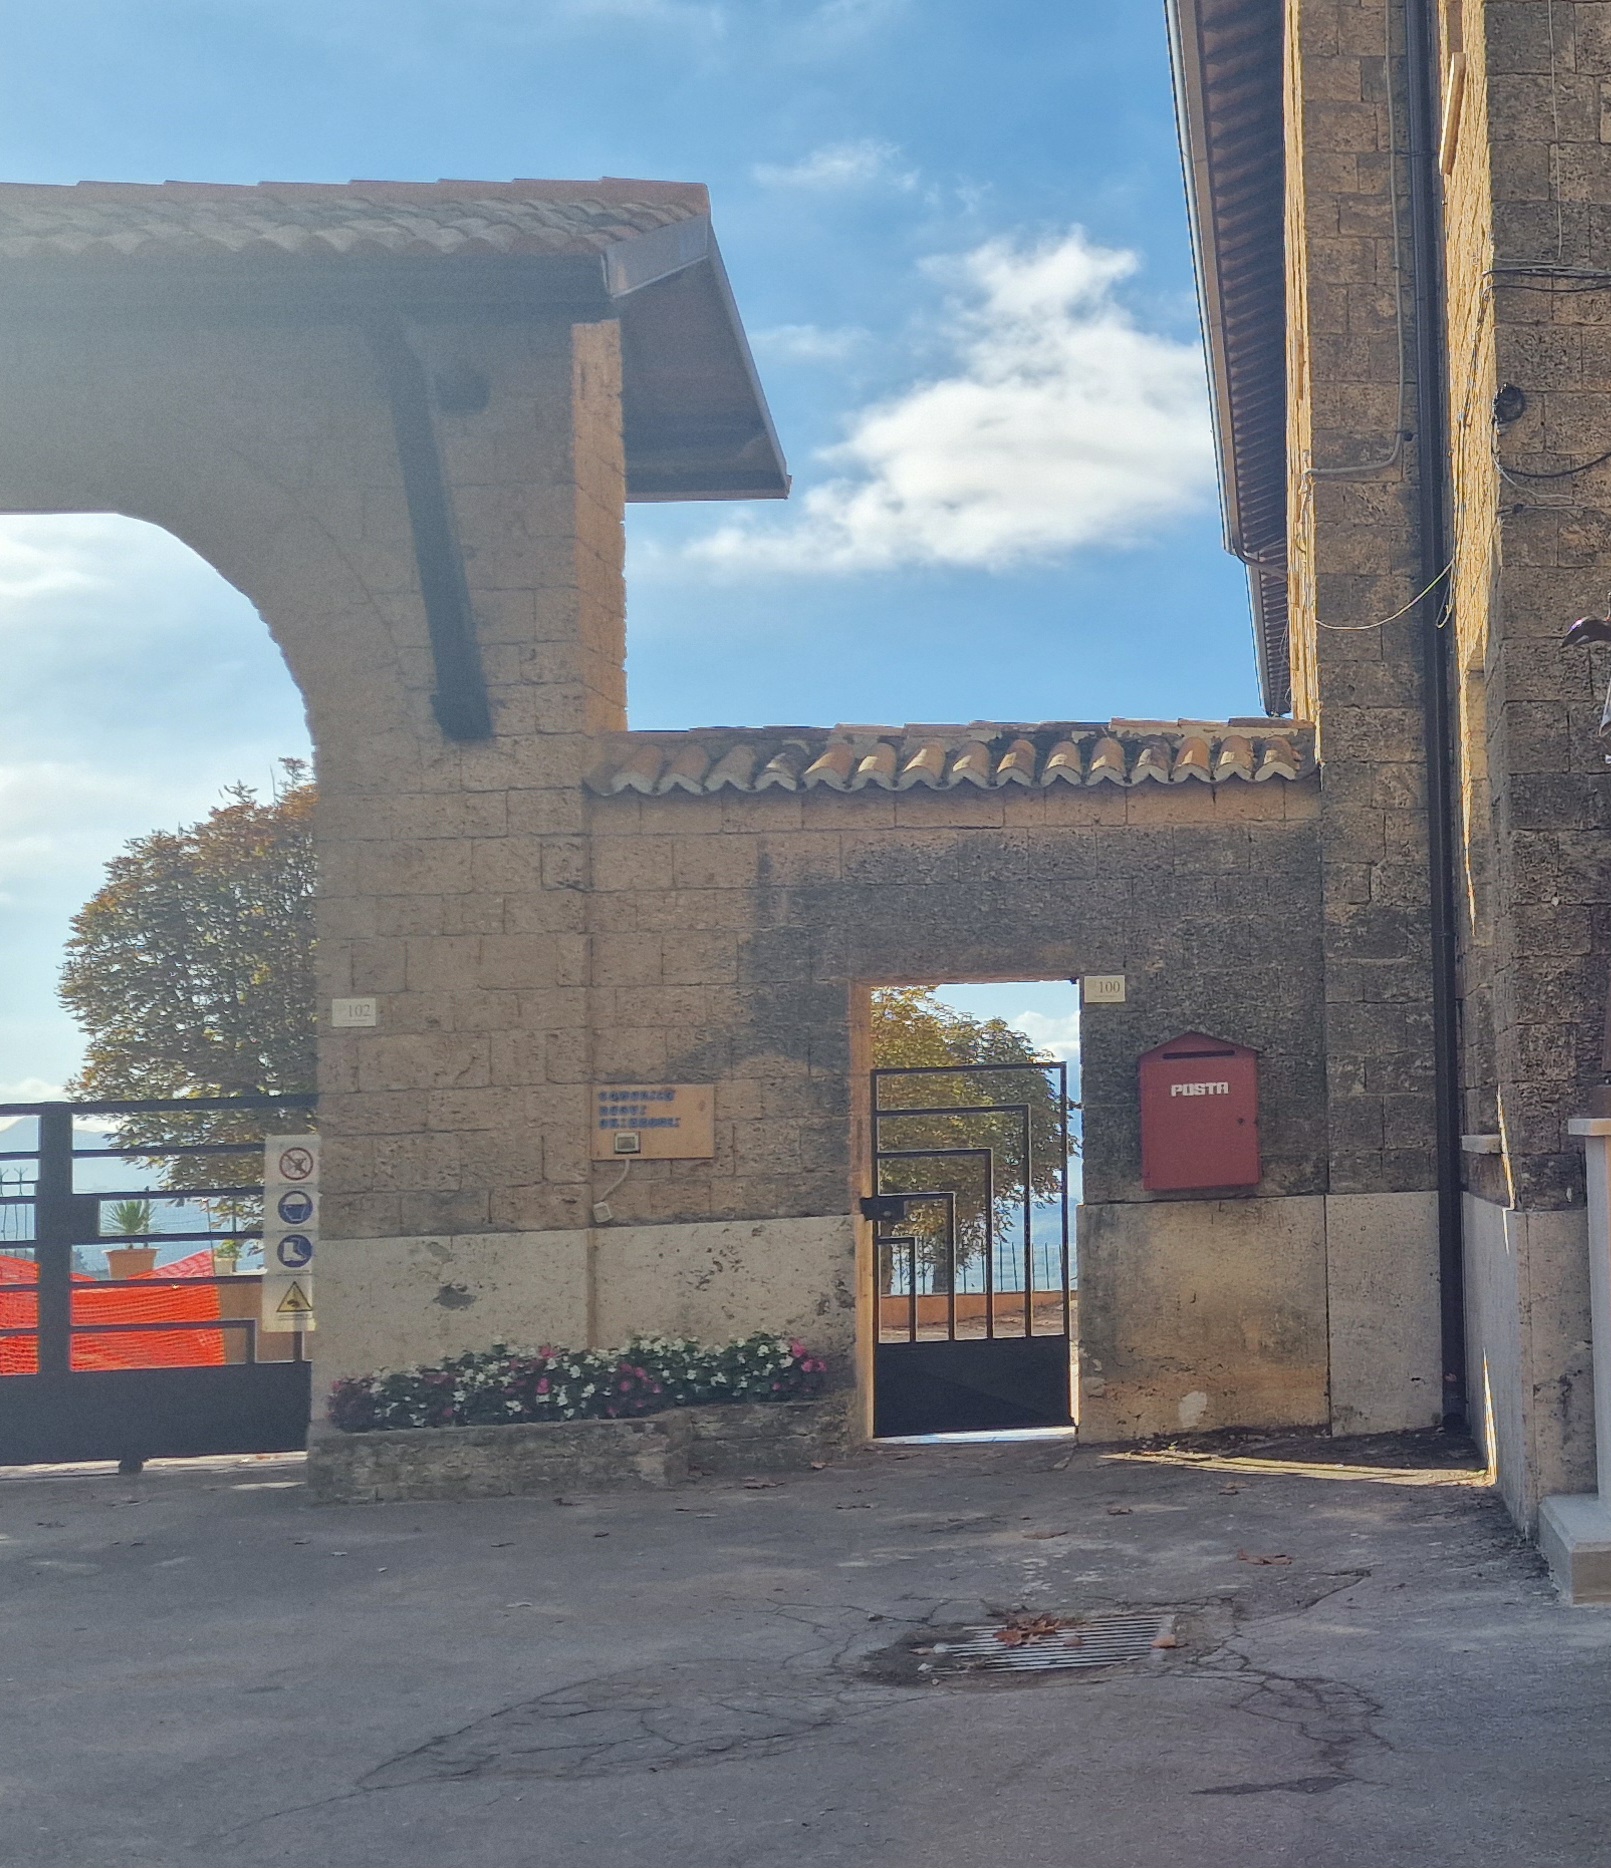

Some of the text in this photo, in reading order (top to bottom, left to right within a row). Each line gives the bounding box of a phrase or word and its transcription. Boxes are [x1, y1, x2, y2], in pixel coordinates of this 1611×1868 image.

[1099, 981, 1120, 993] 100
[349, 1004, 370, 1017] 102
[1171, 1081, 1229, 1097] POSTA
